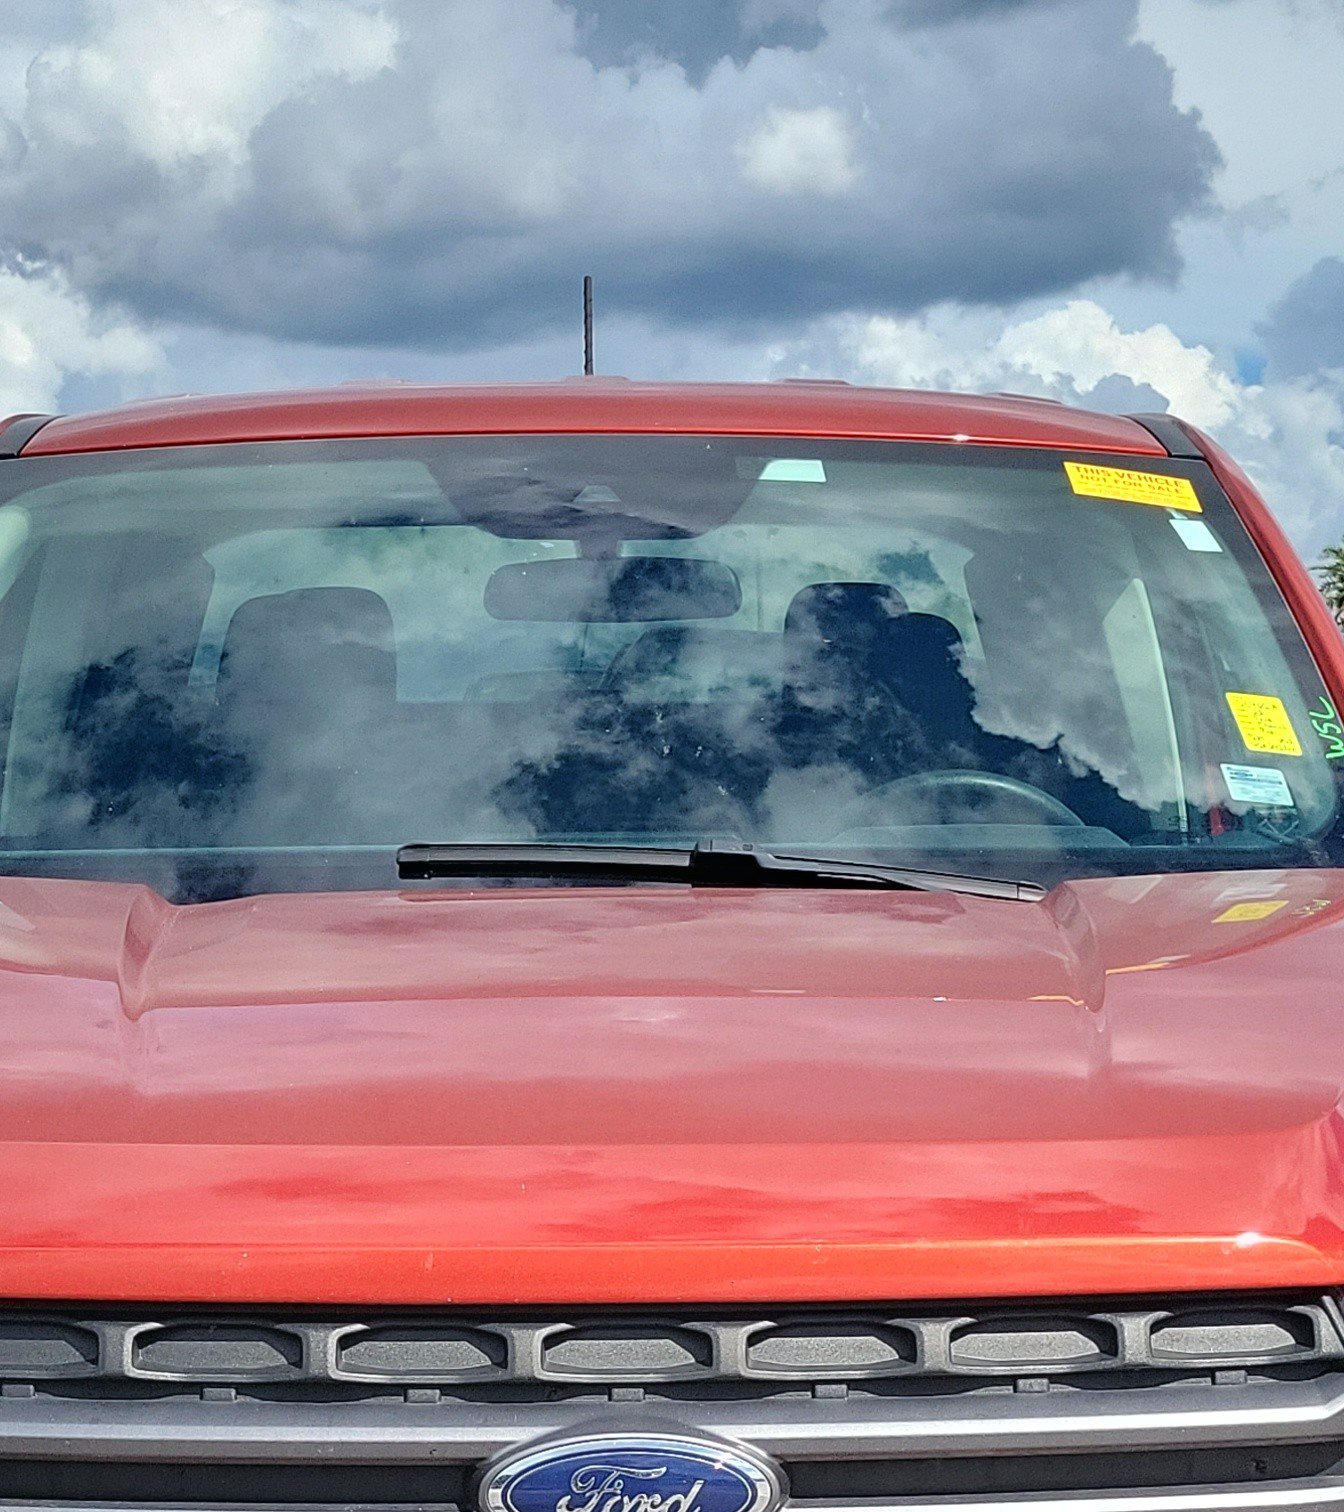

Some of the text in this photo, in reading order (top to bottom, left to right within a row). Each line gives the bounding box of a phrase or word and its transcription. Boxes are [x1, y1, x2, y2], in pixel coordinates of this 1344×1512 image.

[1072, 465, 1185, 489] THIS VEHICLE
[1080, 474, 1183, 495] NOT FOR SALE
